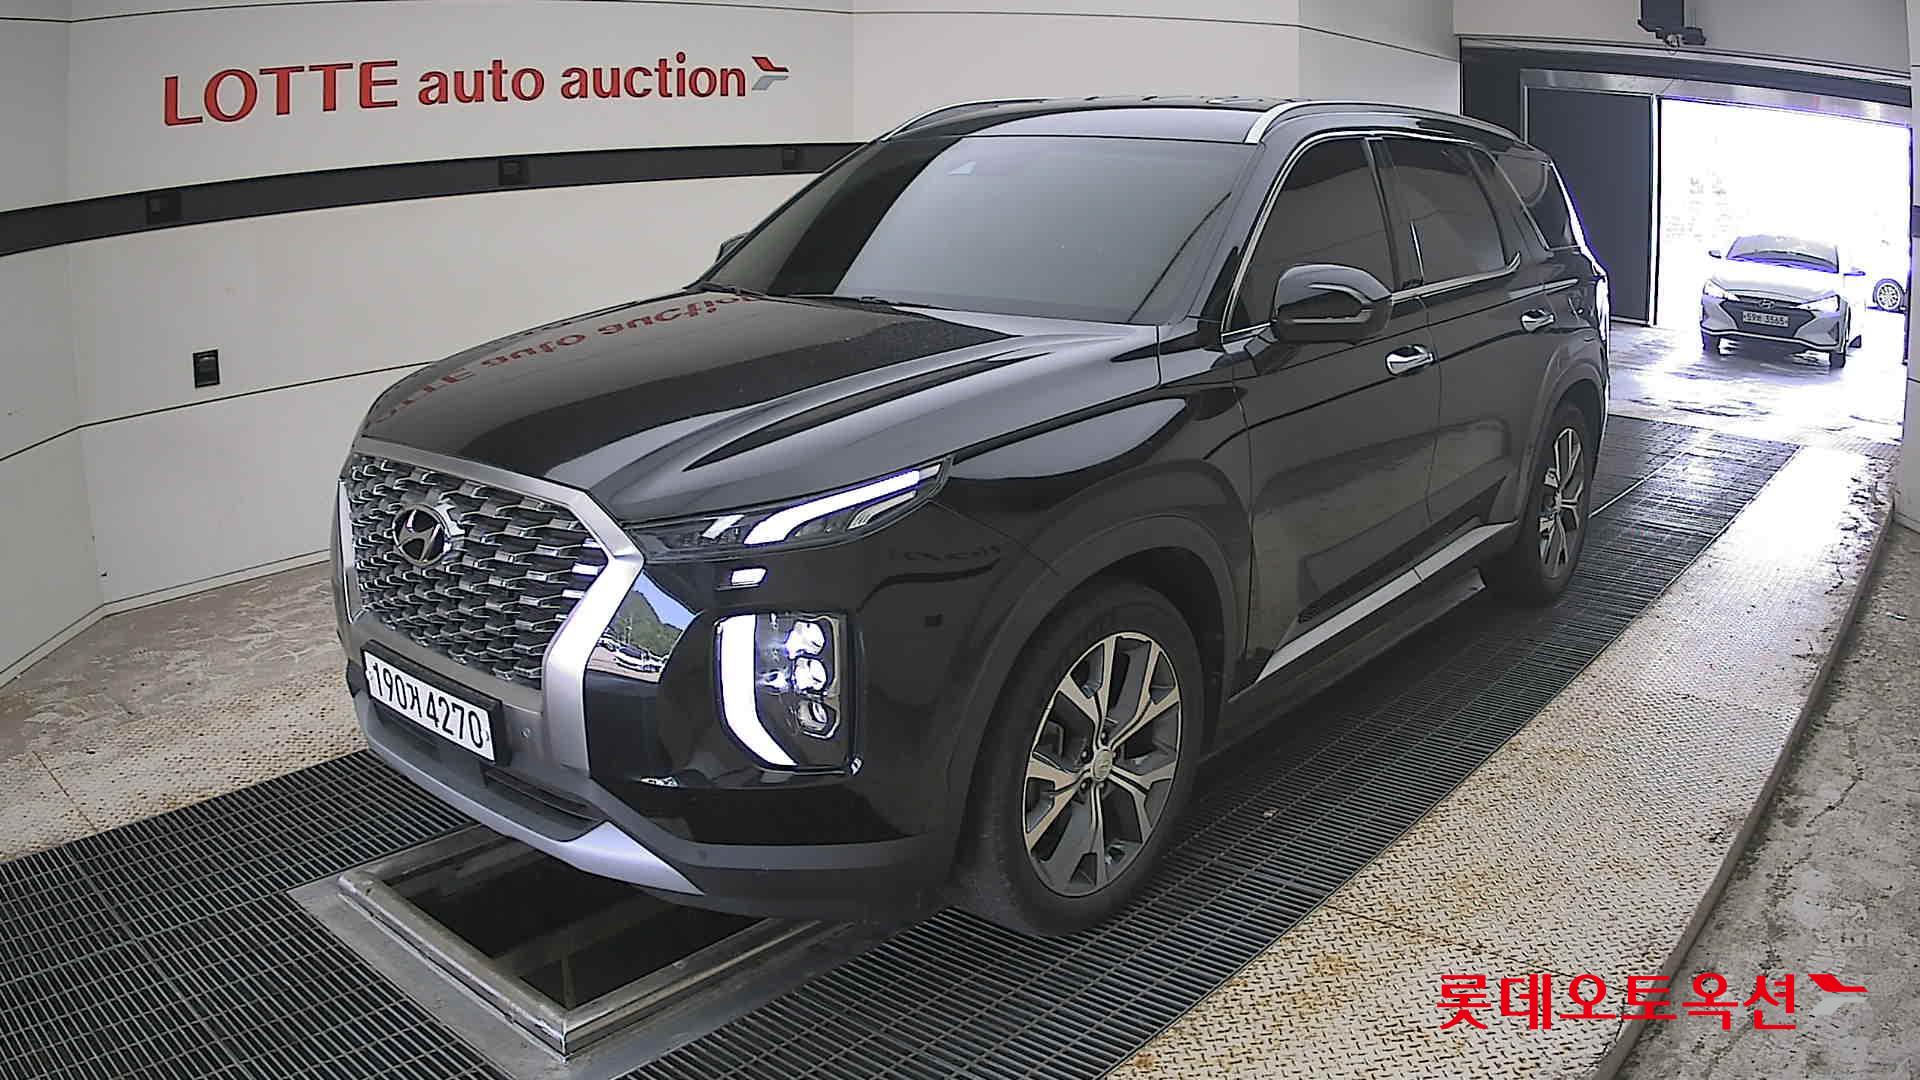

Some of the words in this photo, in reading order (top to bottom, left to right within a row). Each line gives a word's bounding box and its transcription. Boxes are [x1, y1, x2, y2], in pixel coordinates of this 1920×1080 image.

[164, 60, 398, 126] LOTTE
[417, 60, 546, 105] auto
[561, 52, 746, 99] auction
